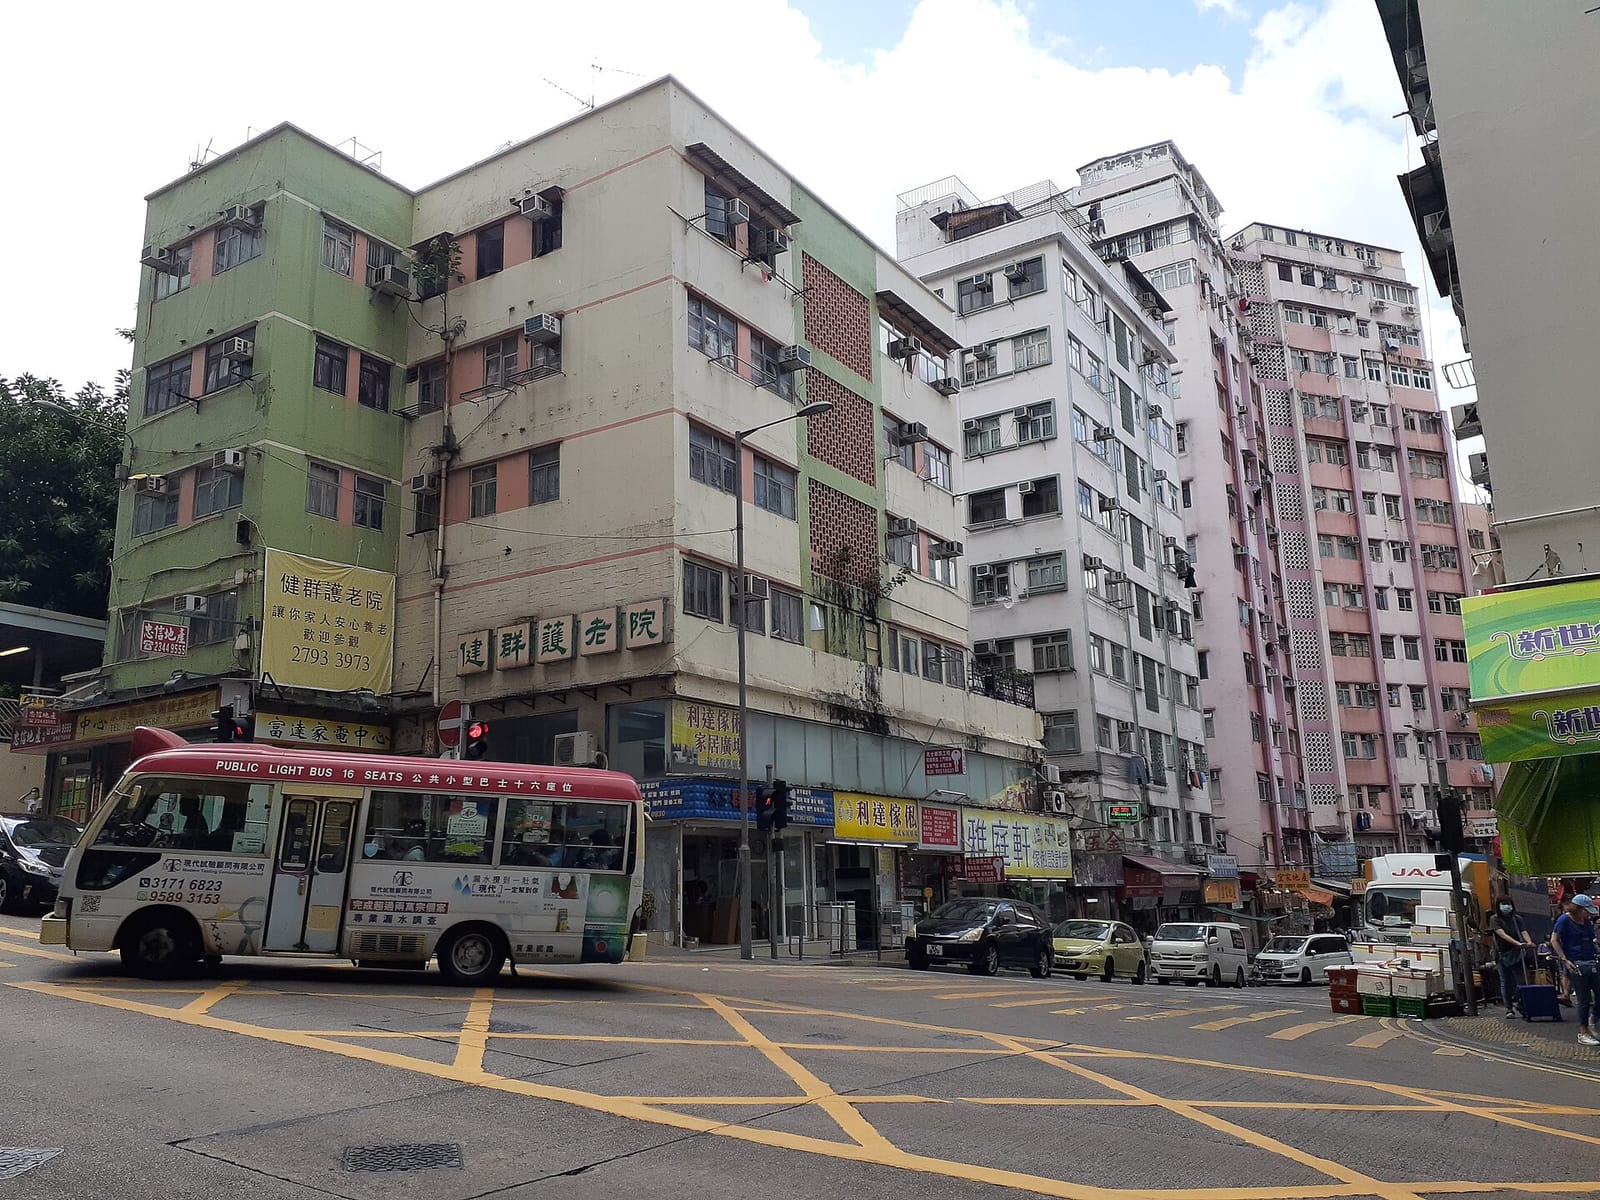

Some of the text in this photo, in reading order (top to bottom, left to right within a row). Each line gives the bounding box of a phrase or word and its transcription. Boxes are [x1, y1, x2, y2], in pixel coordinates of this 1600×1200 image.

[281, 573, 383, 611] 健群護老院
[272, 605, 387, 636] 讓你家人安心養老
[144, 623, 186, 645] 忠信地產
[303, 628, 359, 648] 歡迎參觀
[460, 609, 659, 667] 健群護老院
[1517, 621, 1600, 654] 新世
[292, 646, 370, 671] 2793 3973
[80, 716, 107, 736] 中心
[268, 716, 390, 747] 富達家電中心
[216, 761, 403, 781] PUBLIC LIGHT BUS 16 SEATS
[412, 773, 572, 792] 公共小型巴士十六座位
[856, 800, 918, 828] 利達傢俬
[1392, 868, 1441, 877] JAC
[151, 878, 222, 891] 3171 6823
[149, 891, 220, 904] 9589 3153
